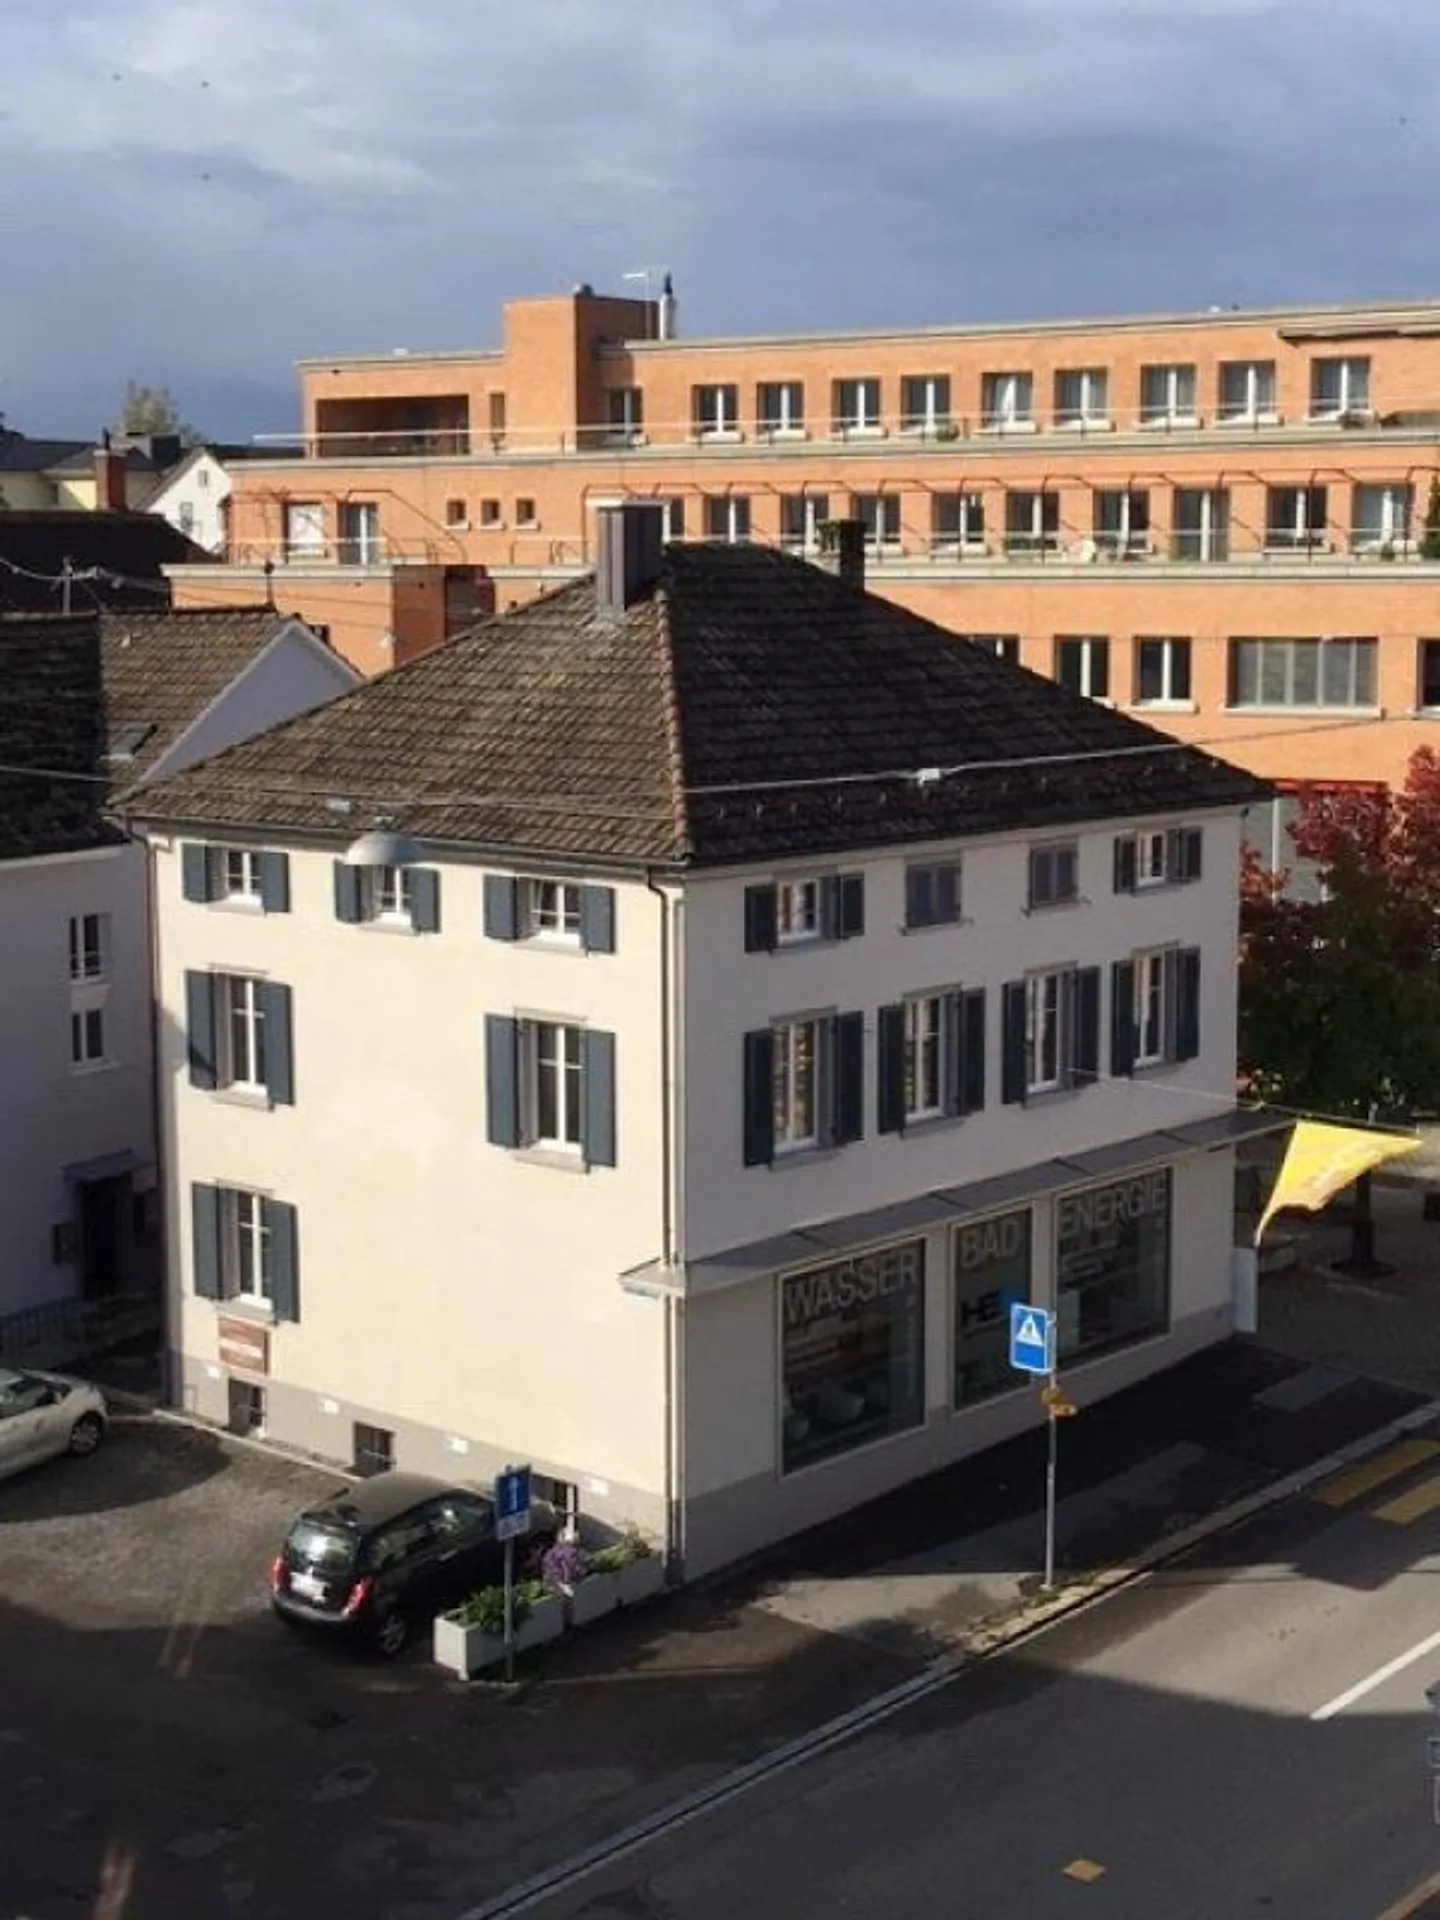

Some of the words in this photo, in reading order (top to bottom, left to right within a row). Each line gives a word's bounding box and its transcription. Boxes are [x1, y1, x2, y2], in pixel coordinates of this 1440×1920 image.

[784, 1249, 917, 1321] WASSER
[960, 1221, 1019, 1269] BAD
[1058, 1173, 1168, 1239] ENERGIE
